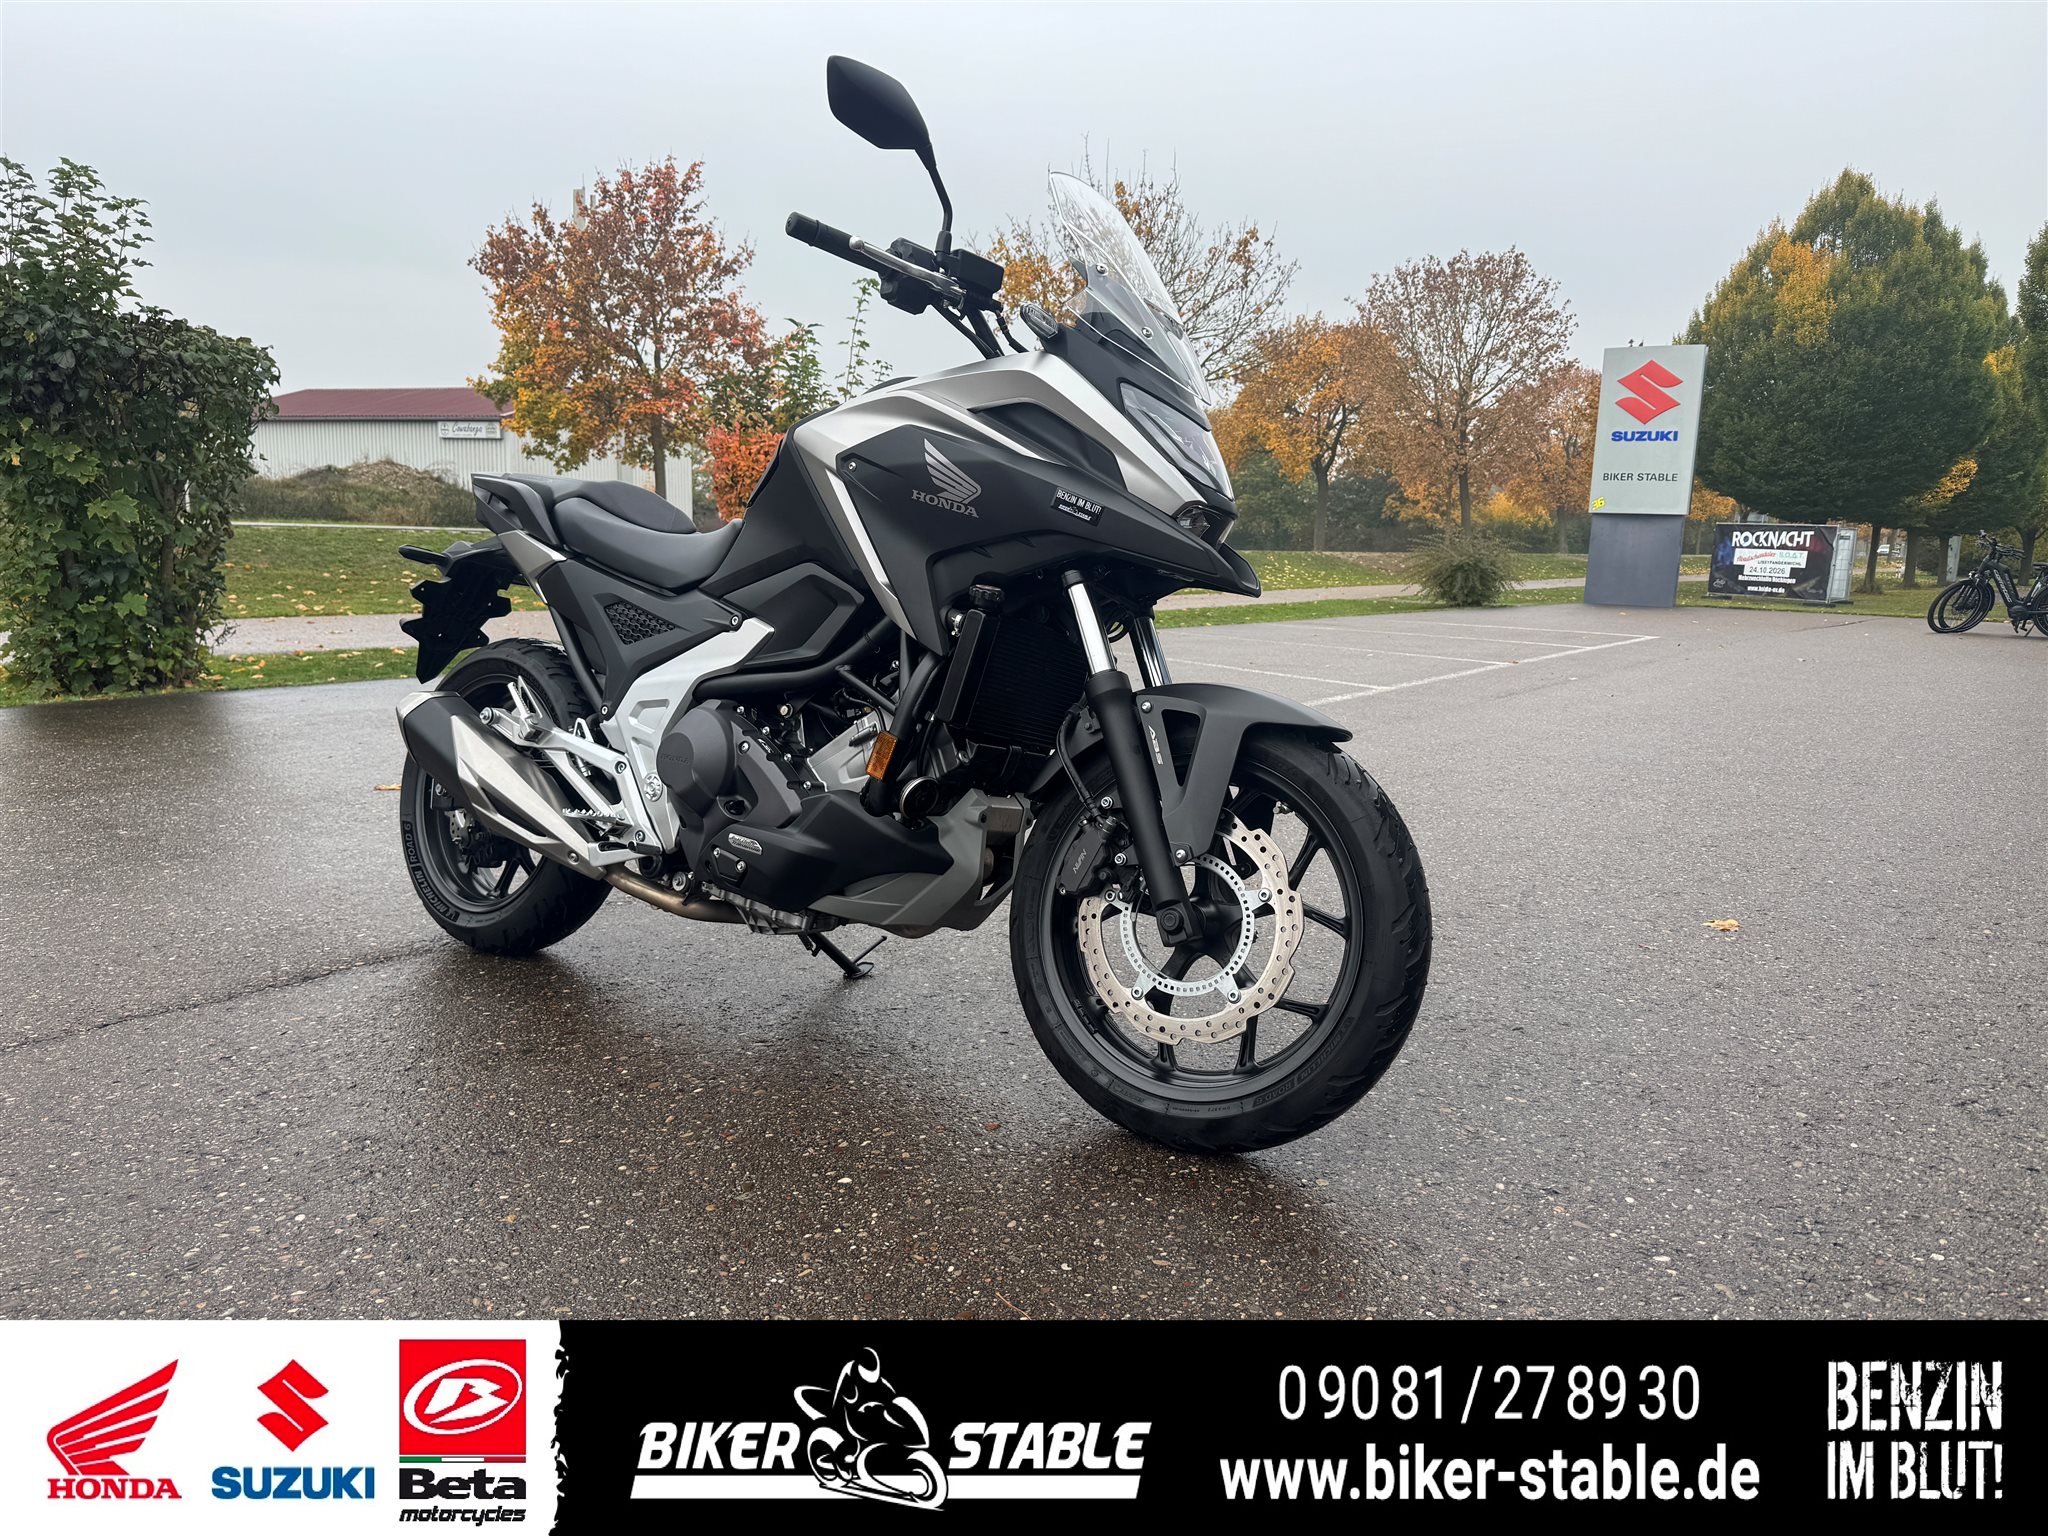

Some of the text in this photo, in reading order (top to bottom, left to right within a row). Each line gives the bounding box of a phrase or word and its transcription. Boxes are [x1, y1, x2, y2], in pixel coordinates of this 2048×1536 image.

[1611, 431, 1678, 442] SUZUKI
[1603, 472, 1678, 482] BIKER STABLE
[911, 489, 979, 518] HONDA
[1591, 497, 1605, 510] 36
[1731, 531, 1814, 549] ROCKNACHT
[1749, 565, 1786, 575] 24.10.2026
[1148, 725, 1164, 765] ABS
[403, 822, 449, 915] MICHELIN ROAD 6
[1300, 1033, 1342, 1080] MICHELIN
[1265, 1082, 1293, 1101] ROAD
